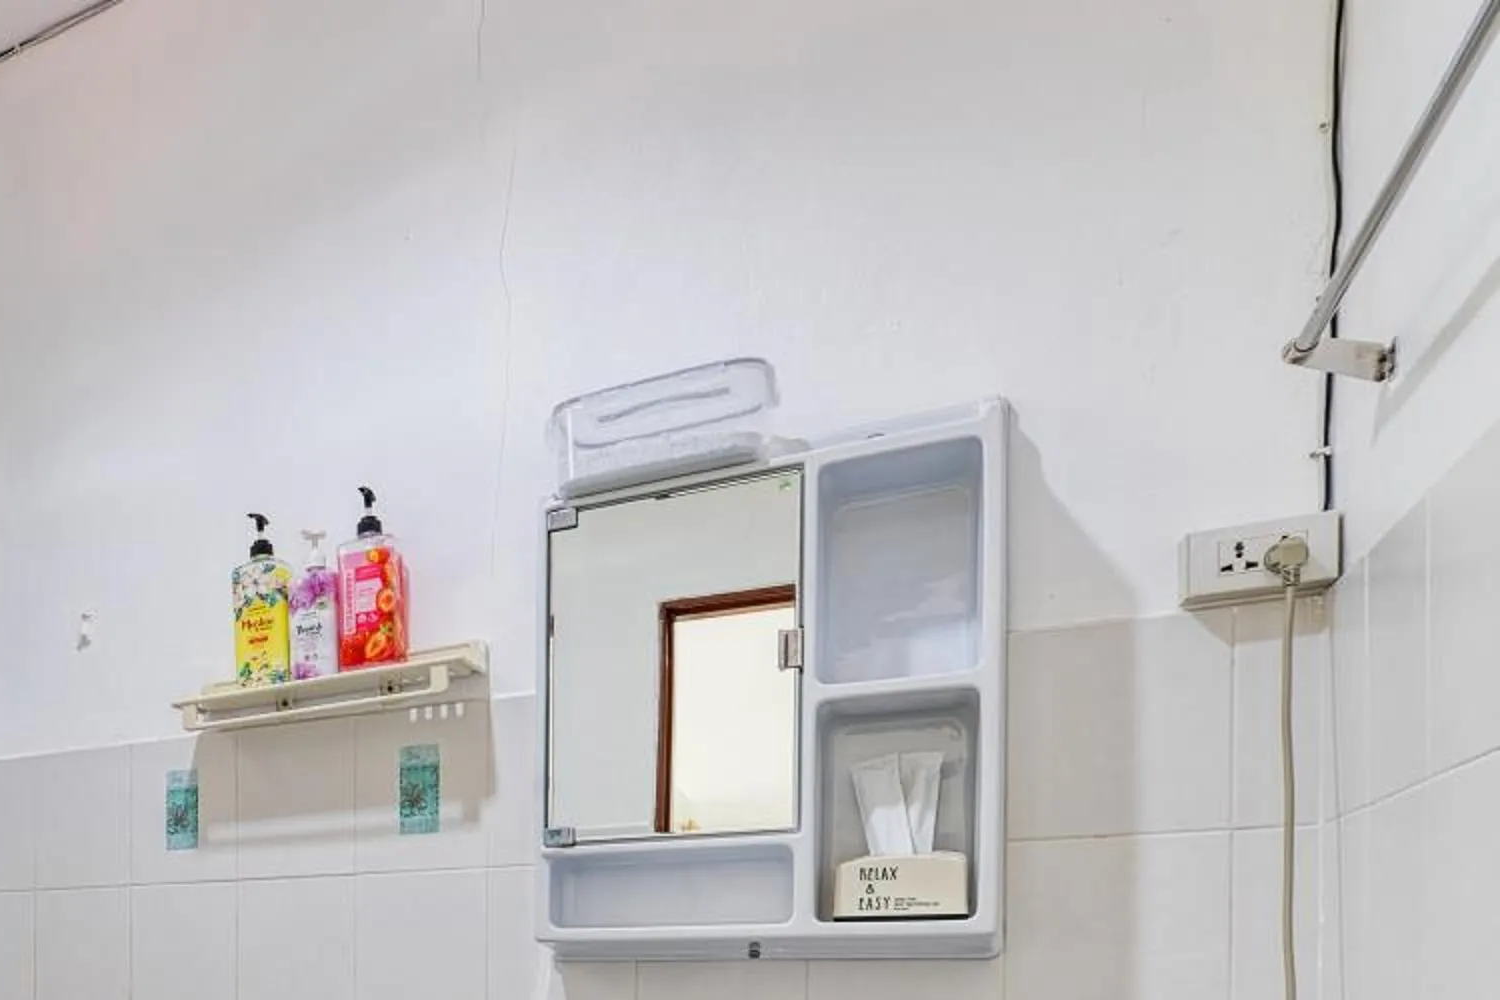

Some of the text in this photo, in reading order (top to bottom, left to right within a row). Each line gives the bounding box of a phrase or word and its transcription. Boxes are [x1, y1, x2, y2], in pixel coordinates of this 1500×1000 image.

[859, 865, 899, 881] RELAX
[865, 883, 875, 895] &
[858, 896, 891, 911] EASY
